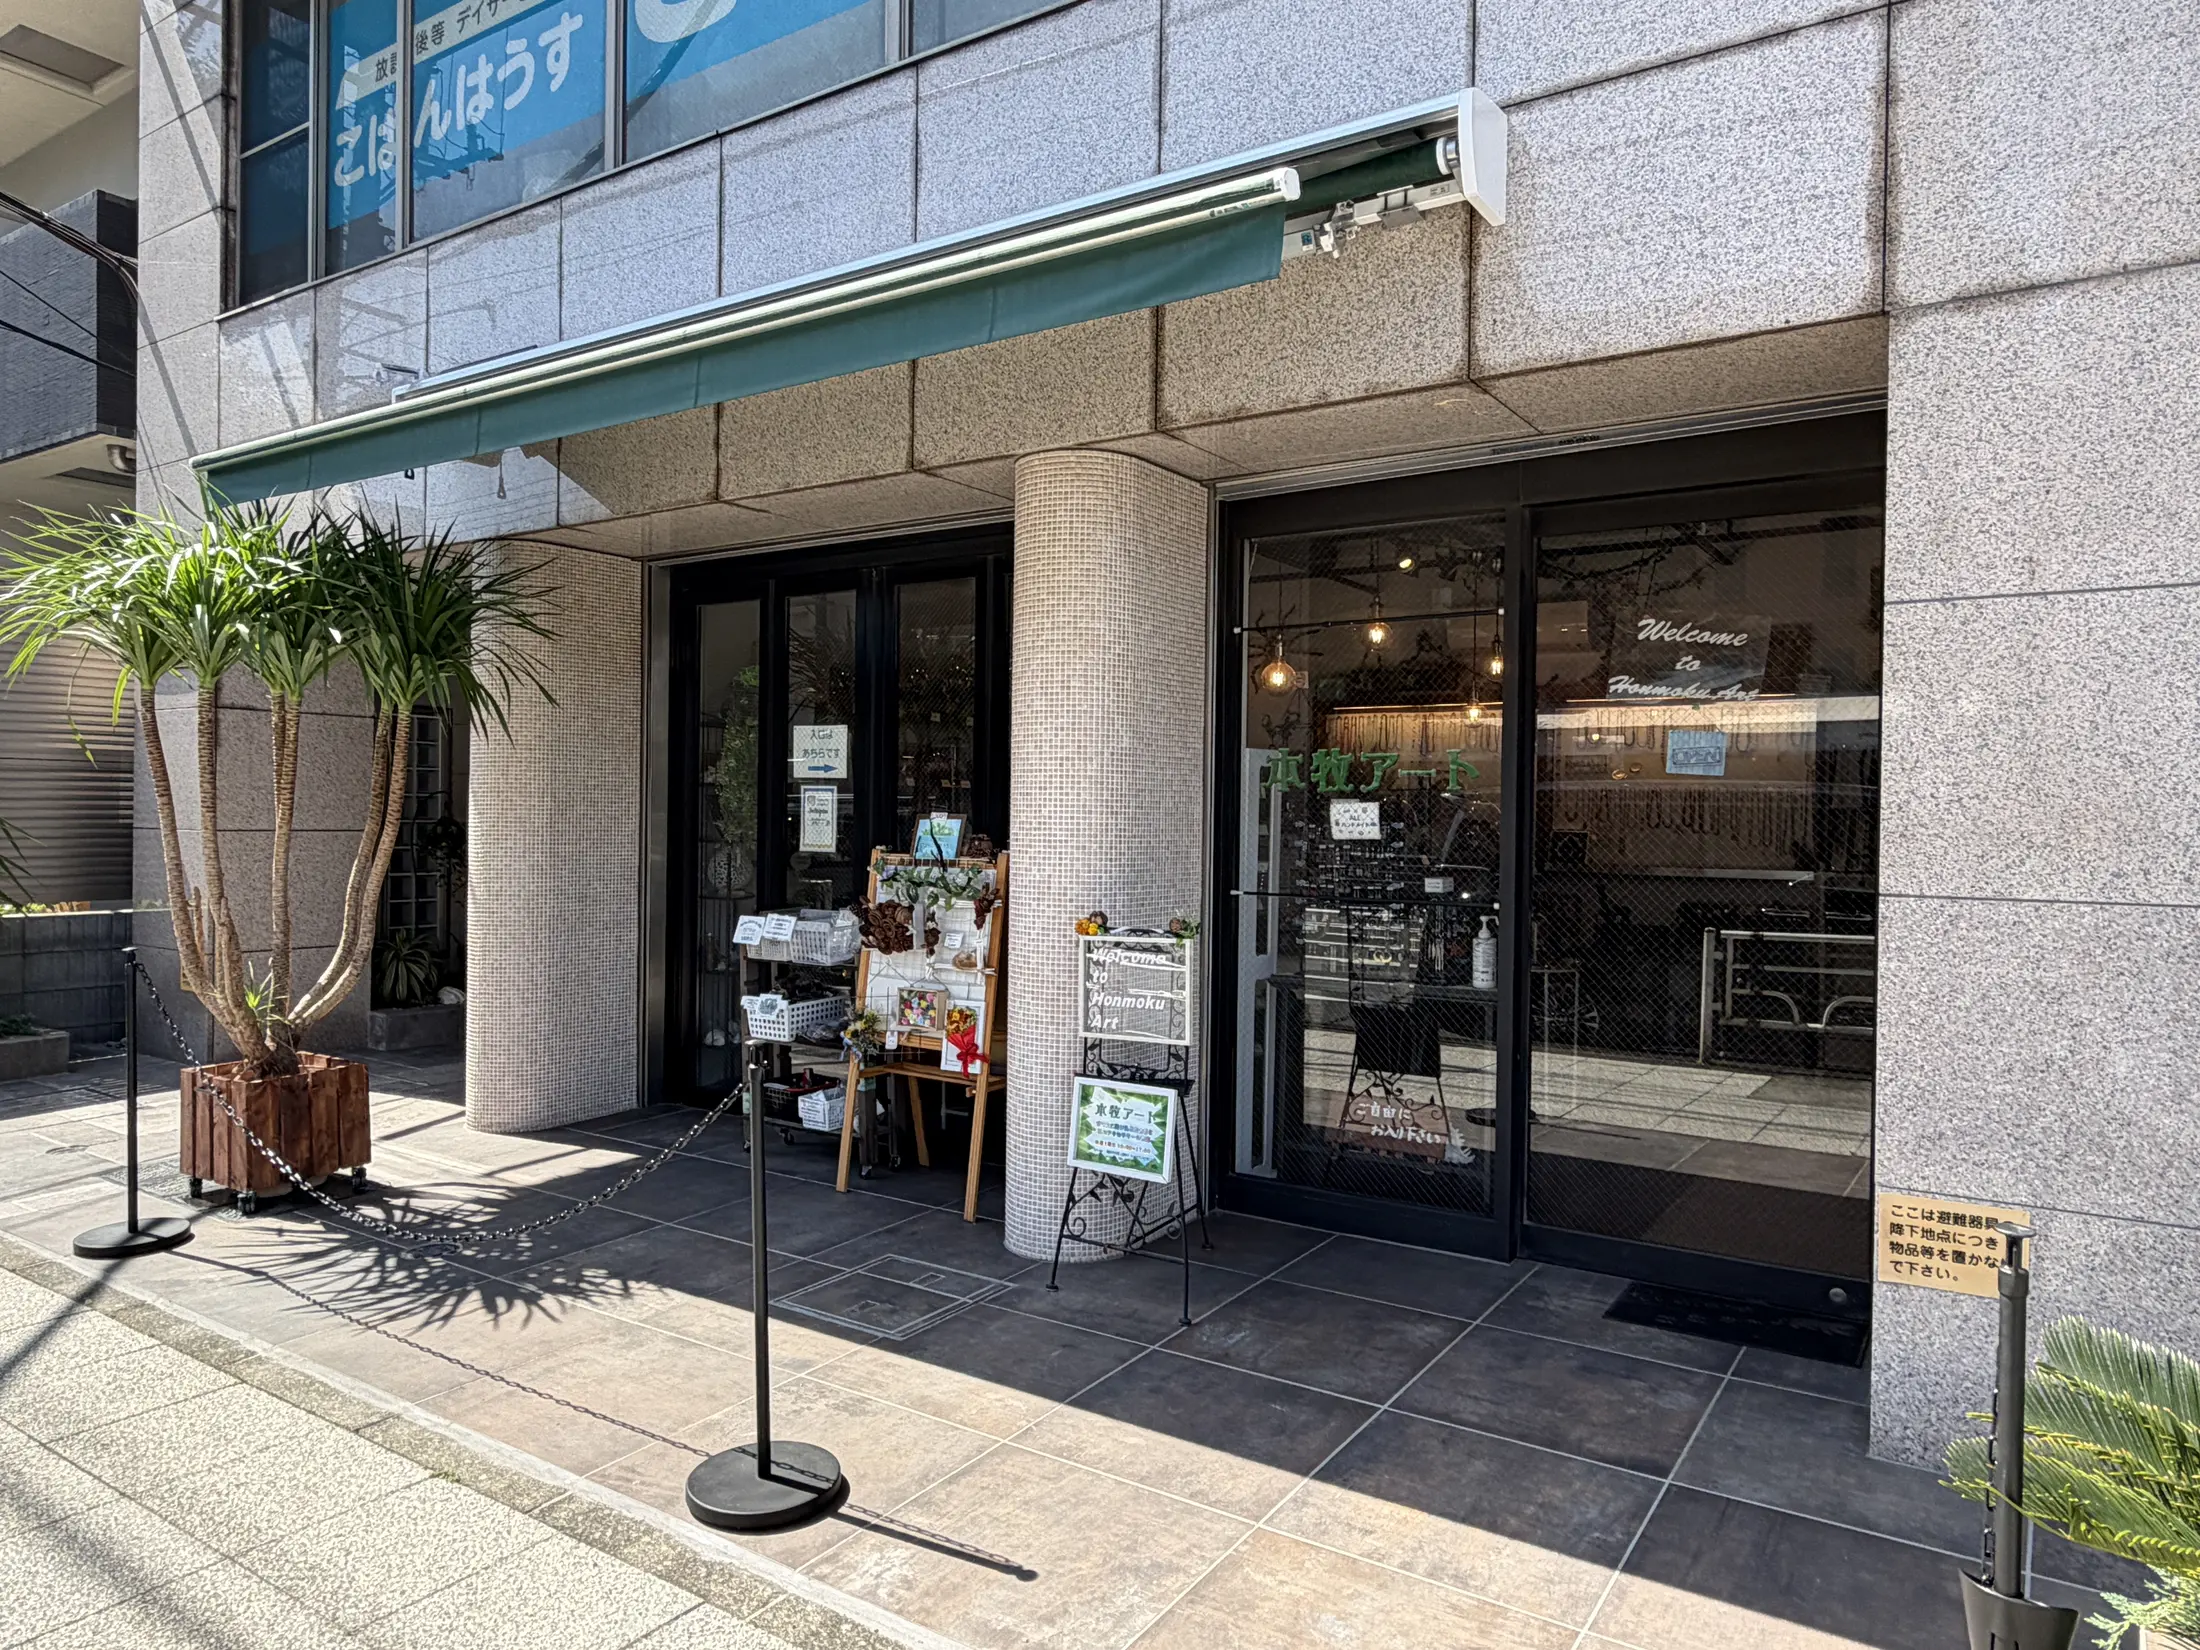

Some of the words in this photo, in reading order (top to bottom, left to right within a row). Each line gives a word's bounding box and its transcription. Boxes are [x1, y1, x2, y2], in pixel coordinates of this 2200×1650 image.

[1637, 618, 1748, 647] Welcome
[1674, 654, 1701, 671] to
[1608, 675, 1711, 699] Honmoku
[1714, 683, 1760, 701] Art
[810, 729, 833, 740] 入口は
[802, 748, 840, 759] あちらです
[1260, 747, 1481, 793] 本牧アート
[1092, 948, 1166, 965] Welcome
[1093, 969, 1108, 984] to
[1091, 991, 1166, 1010] Honmoku
[1090, 1014, 1119, 1030] Art
[1094, 1102, 1157, 1125] 本牧アート
[1356, 1101, 1412, 1120] ご自由に
[1370, 1124, 1442, 1144] お入り下さい
[1889, 1222, 1999, 1250] 降下地点につき
[1889, 1260, 1959, 1282] で下さい。
